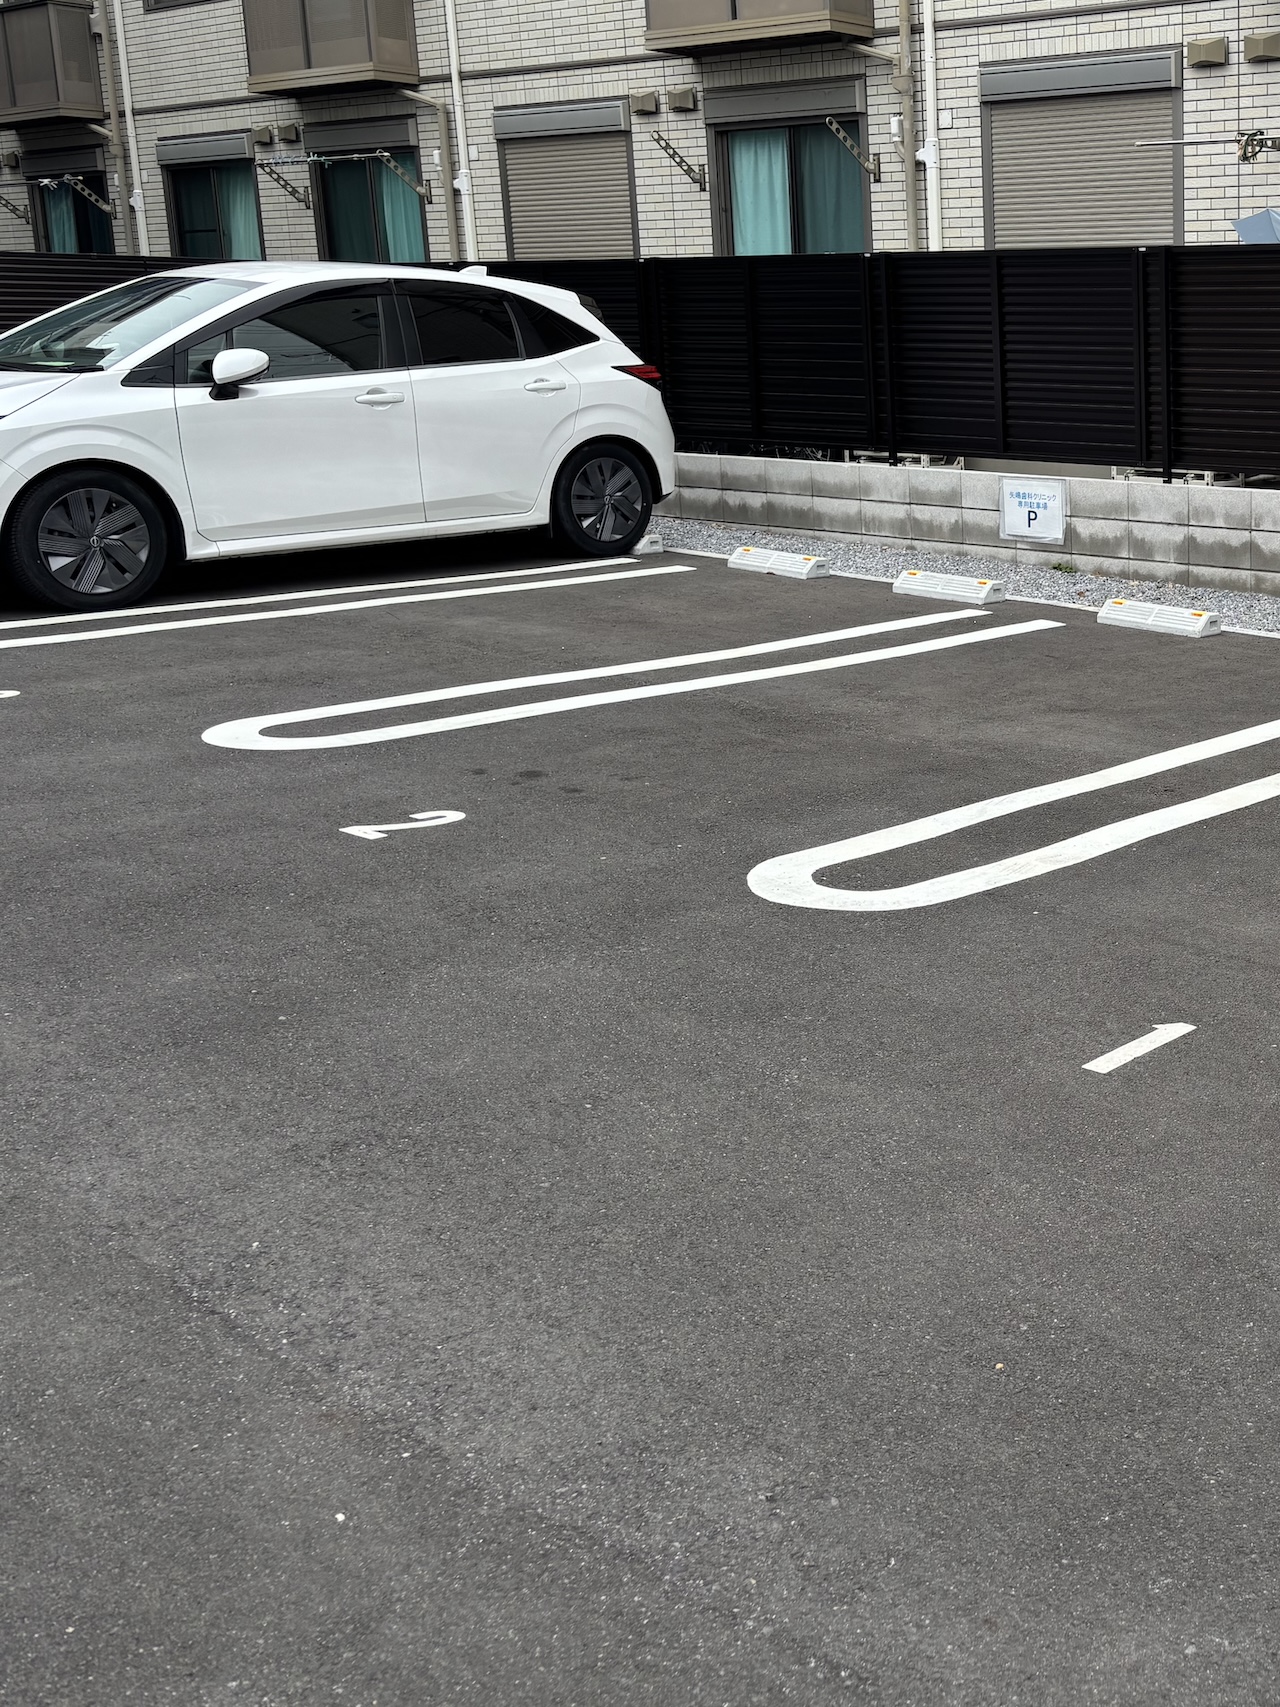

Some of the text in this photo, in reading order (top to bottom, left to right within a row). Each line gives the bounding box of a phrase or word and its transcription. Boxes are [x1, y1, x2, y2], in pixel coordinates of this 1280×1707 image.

[1027, 510, 1038, 528] P
[338, 810, 467, 840] 2
[1081, 1022, 1198, 1074] 1
